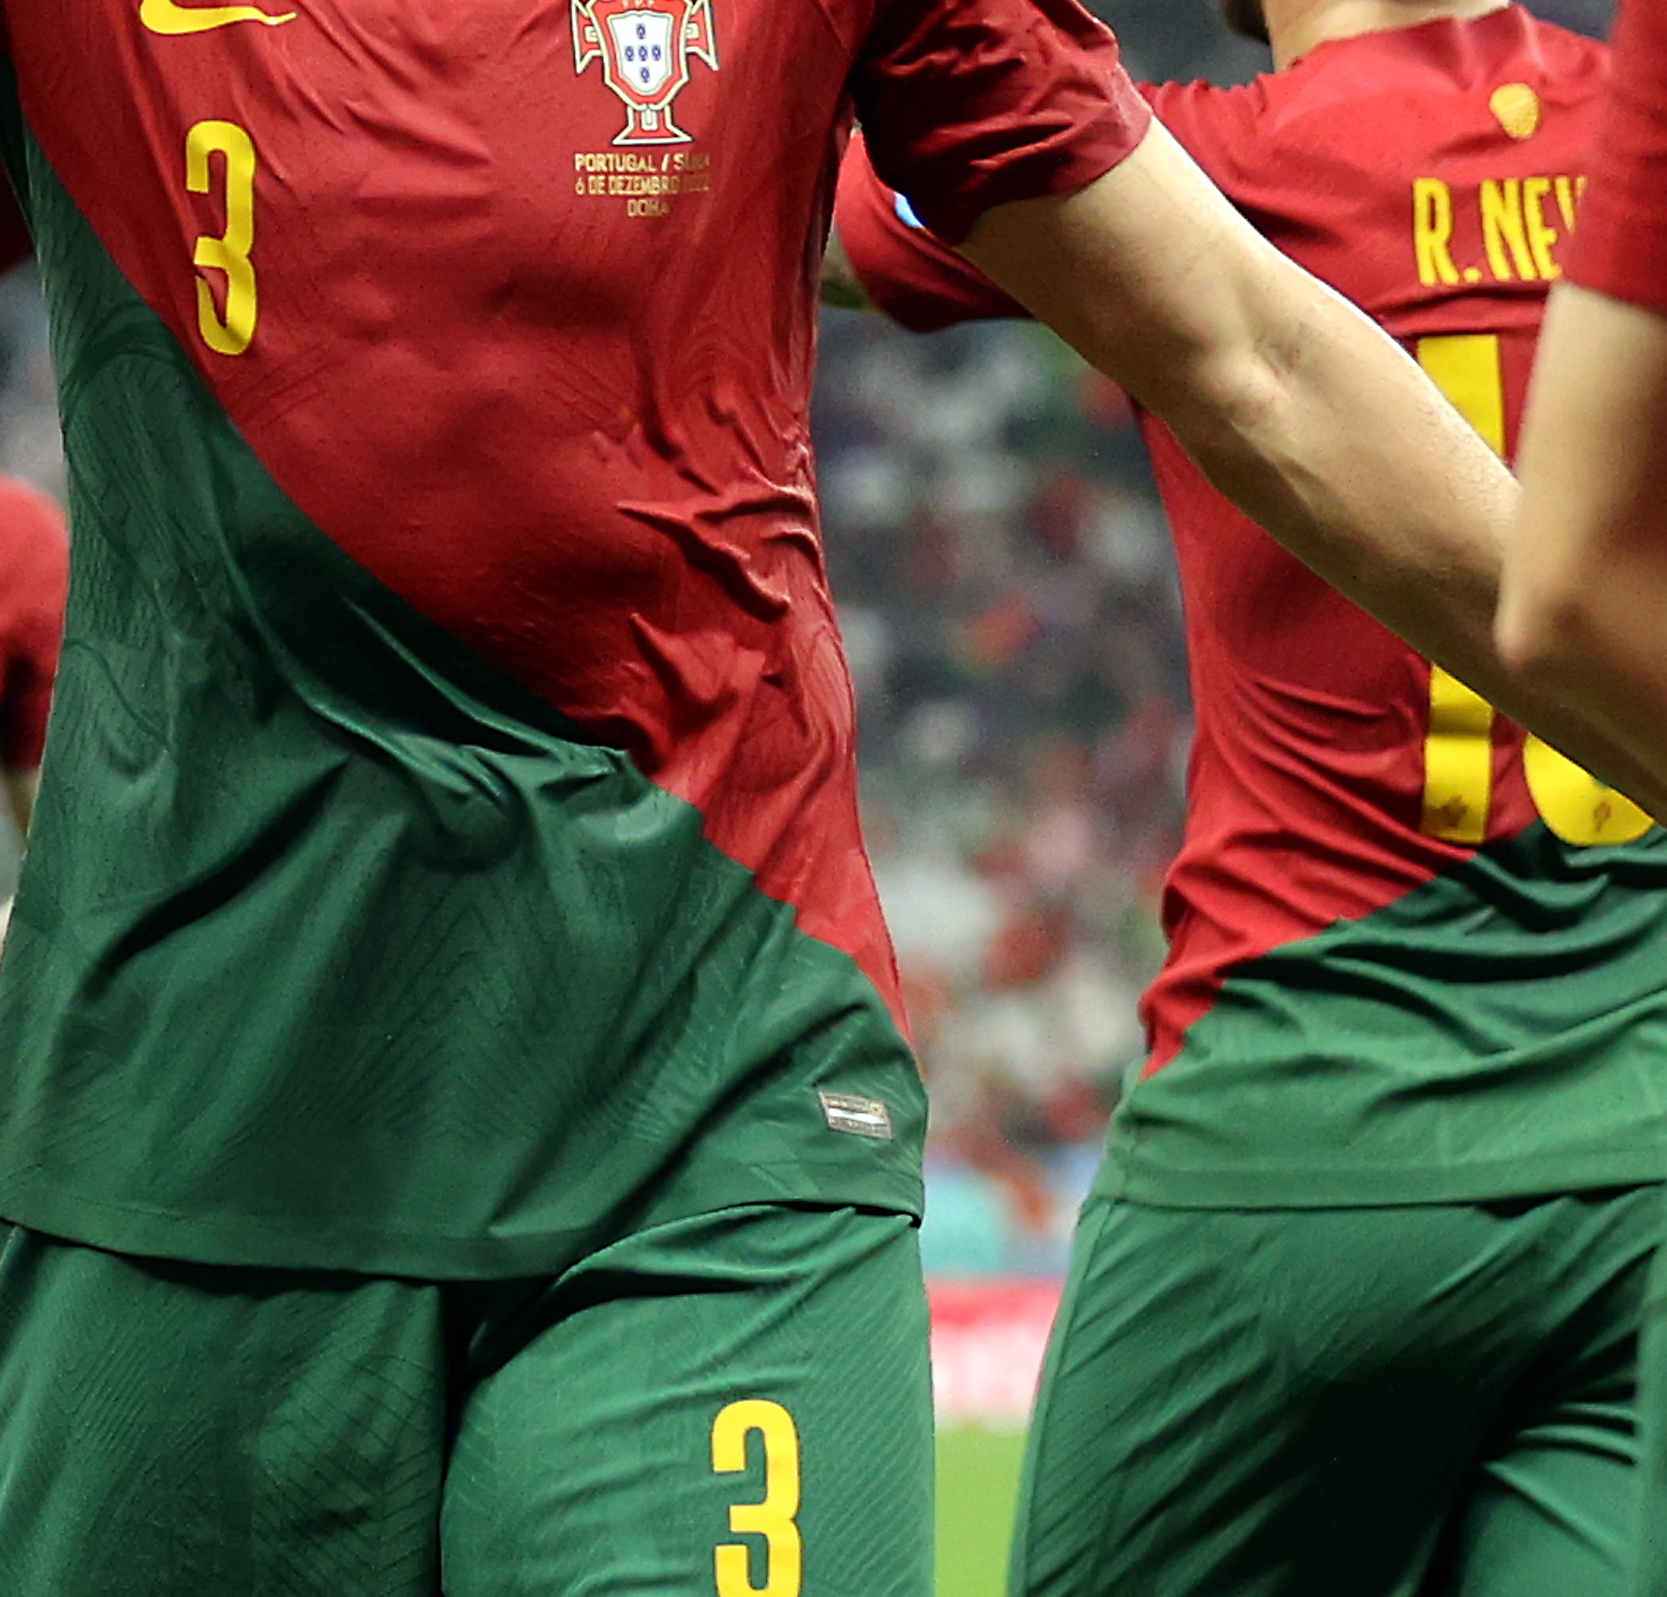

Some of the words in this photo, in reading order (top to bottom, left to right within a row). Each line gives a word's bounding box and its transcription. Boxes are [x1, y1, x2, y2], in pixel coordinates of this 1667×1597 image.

[574, 153, 657, 172] PORTUGAL
[661, 153, 670, 171] /
[575, 176, 585, 195] 6
[588, 175, 605, 195] DE
[608, 175, 680, 195] DEZEMBRO
[627, 199, 670, 217] DOHA
[186, 119, 258, 356] 3
[711, 1399, 803, 1597] 3
